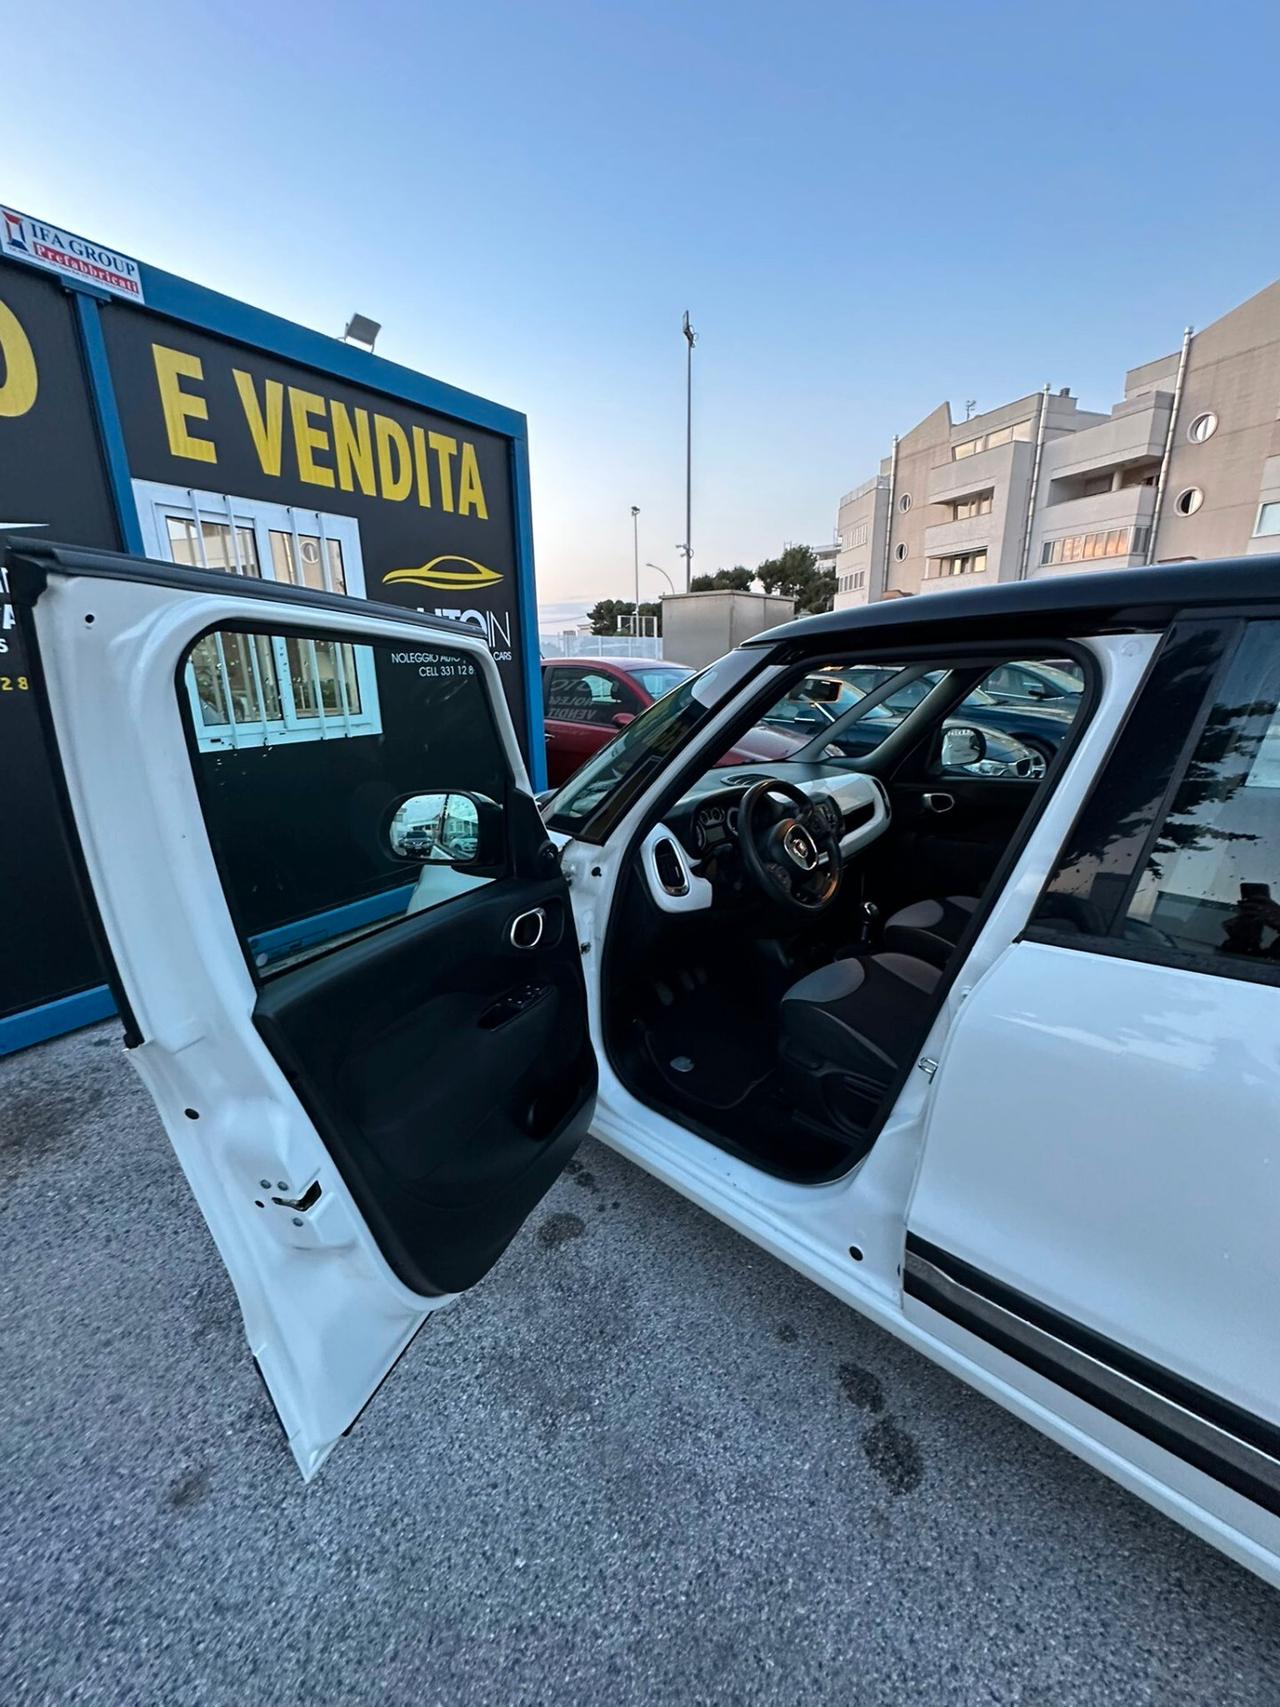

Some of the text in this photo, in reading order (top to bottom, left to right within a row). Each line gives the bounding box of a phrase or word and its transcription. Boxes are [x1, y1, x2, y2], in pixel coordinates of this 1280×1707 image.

[30, 223, 66, 249] IFA
[69, 239, 136, 276] GROUP
[35, 244, 138, 293] Prefabbricati
[151, 343, 218, 464] E
[232, 368, 489, 520] VENDITA
[391, 653, 439, 664] NOLEGGIO
[492, 651, 512, 661] CARS
[418, 666, 439, 677] CELL
[440, 665, 455, 677] 331
